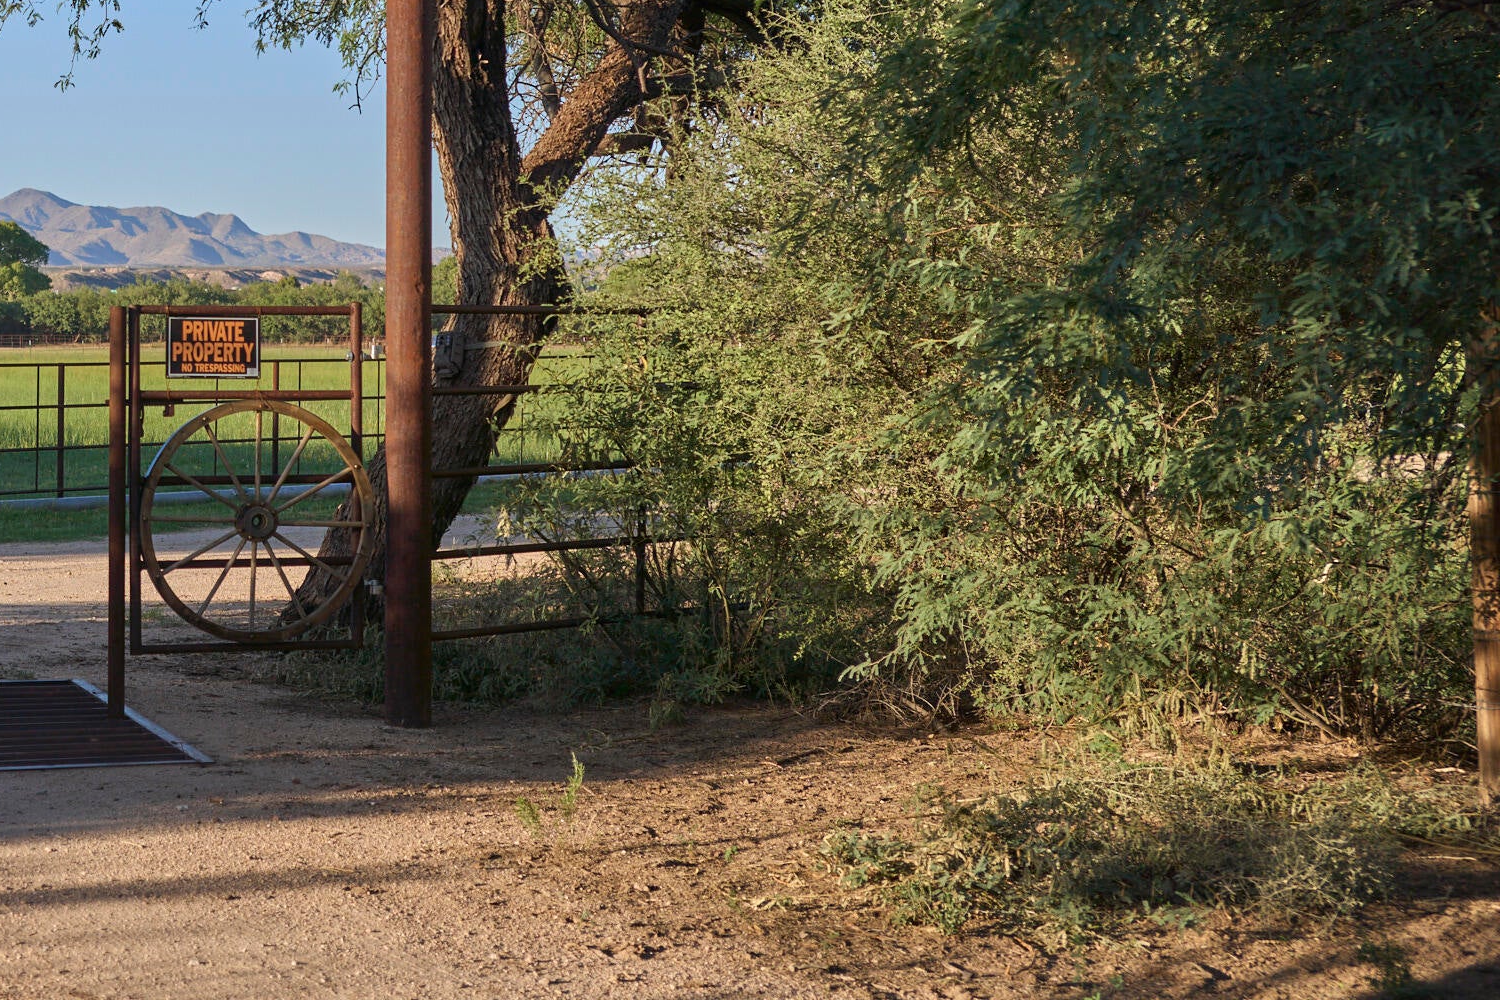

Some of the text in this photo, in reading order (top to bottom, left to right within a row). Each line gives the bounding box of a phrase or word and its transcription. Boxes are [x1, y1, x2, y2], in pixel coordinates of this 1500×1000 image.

[182, 320, 245, 342] PRIVATE
[171, 341, 254, 363] PROPERTY
[181, 363, 246, 373] NO TRESPASSING
